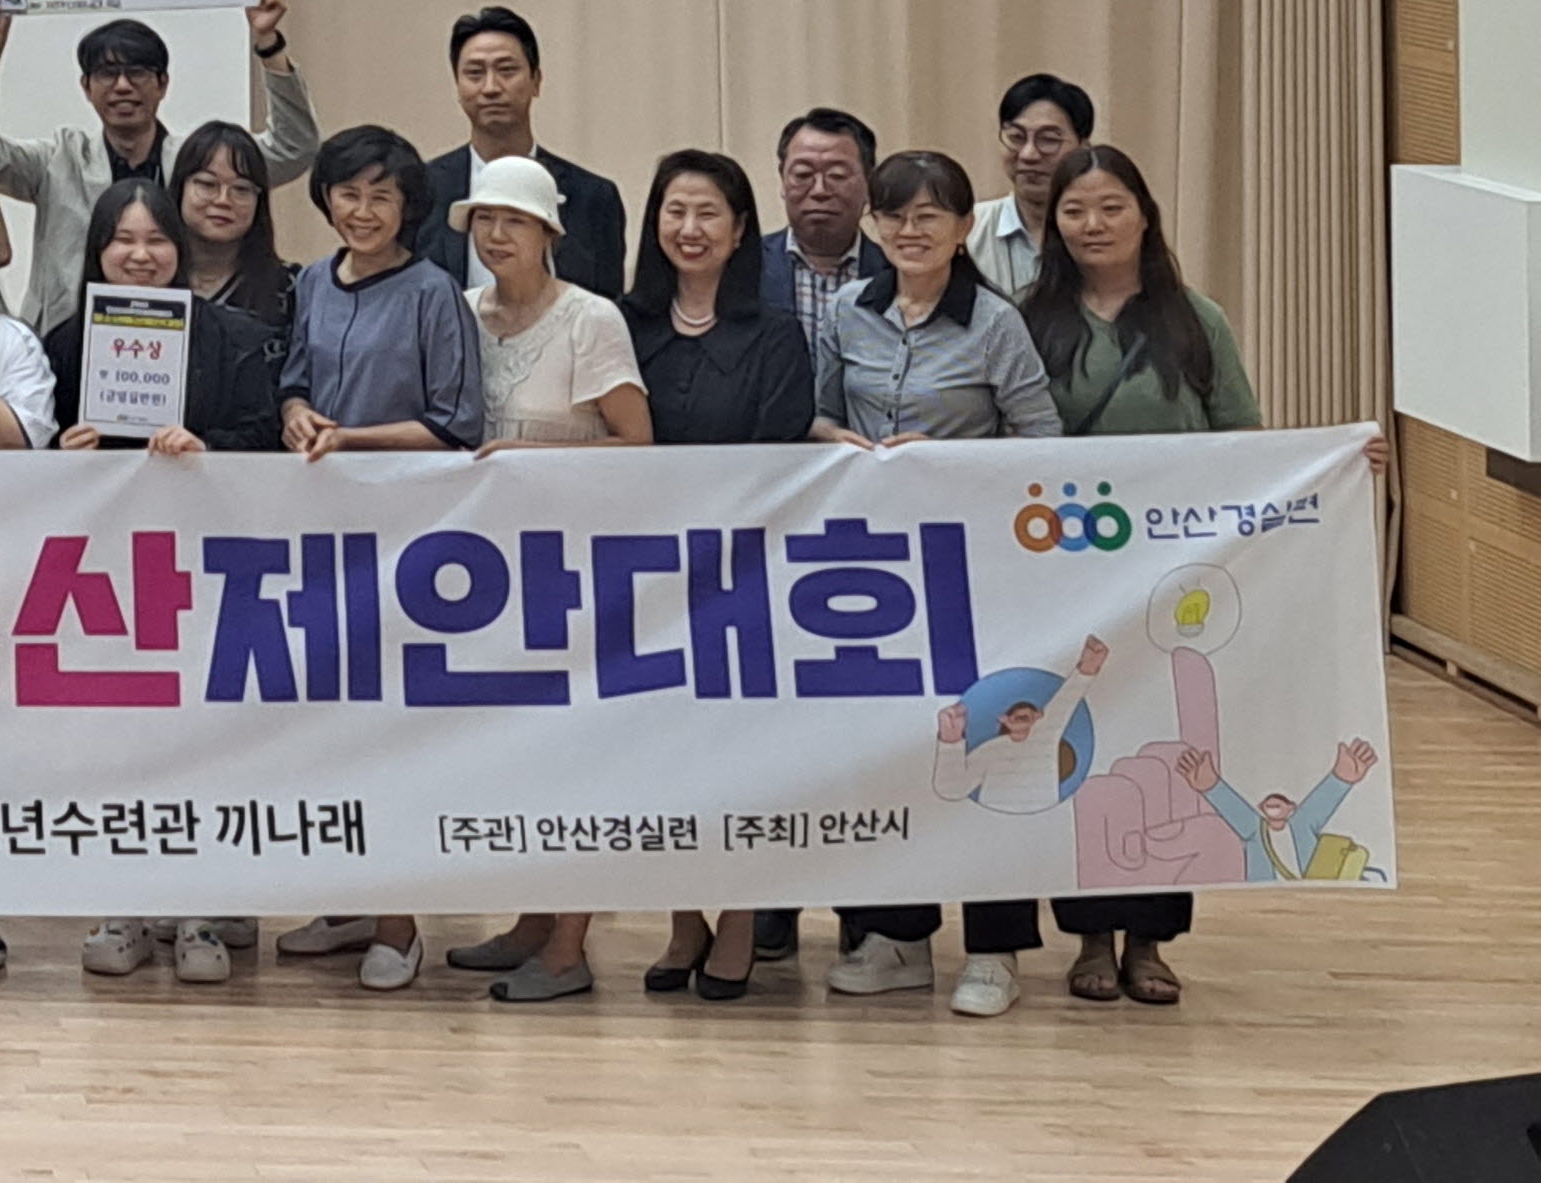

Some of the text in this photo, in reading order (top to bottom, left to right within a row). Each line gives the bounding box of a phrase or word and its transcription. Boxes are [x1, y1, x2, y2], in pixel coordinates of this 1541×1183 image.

[112, 338, 162, 360] 우수상
[1144, 494, 1320, 540] 안산경실련
[215, 799, 366, 857] 끼나래
[438, 814, 528, 857] [주관]
[537, 812, 701, 854] 안산경실련
[723, 808, 810, 852] [주최]
[818, 805, 911, 846] 안산시
